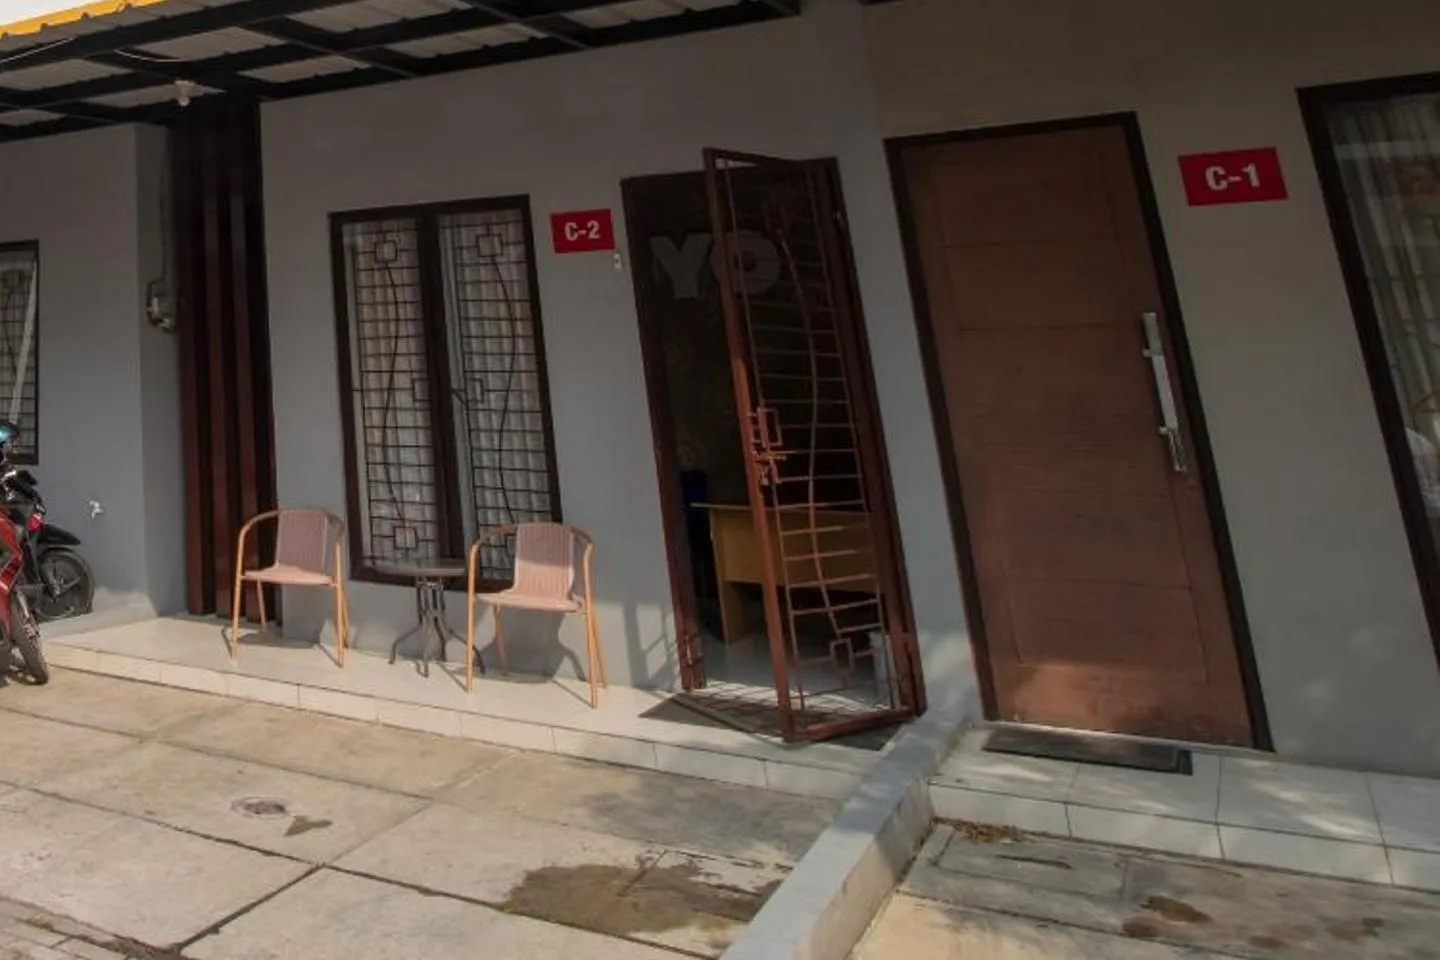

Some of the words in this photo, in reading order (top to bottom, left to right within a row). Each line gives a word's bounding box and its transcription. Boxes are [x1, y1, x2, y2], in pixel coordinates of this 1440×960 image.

[1205, 163, 1260, 191] C-1
[564, 220, 601, 241] C-2
[649, 229, 781, 299] YO
